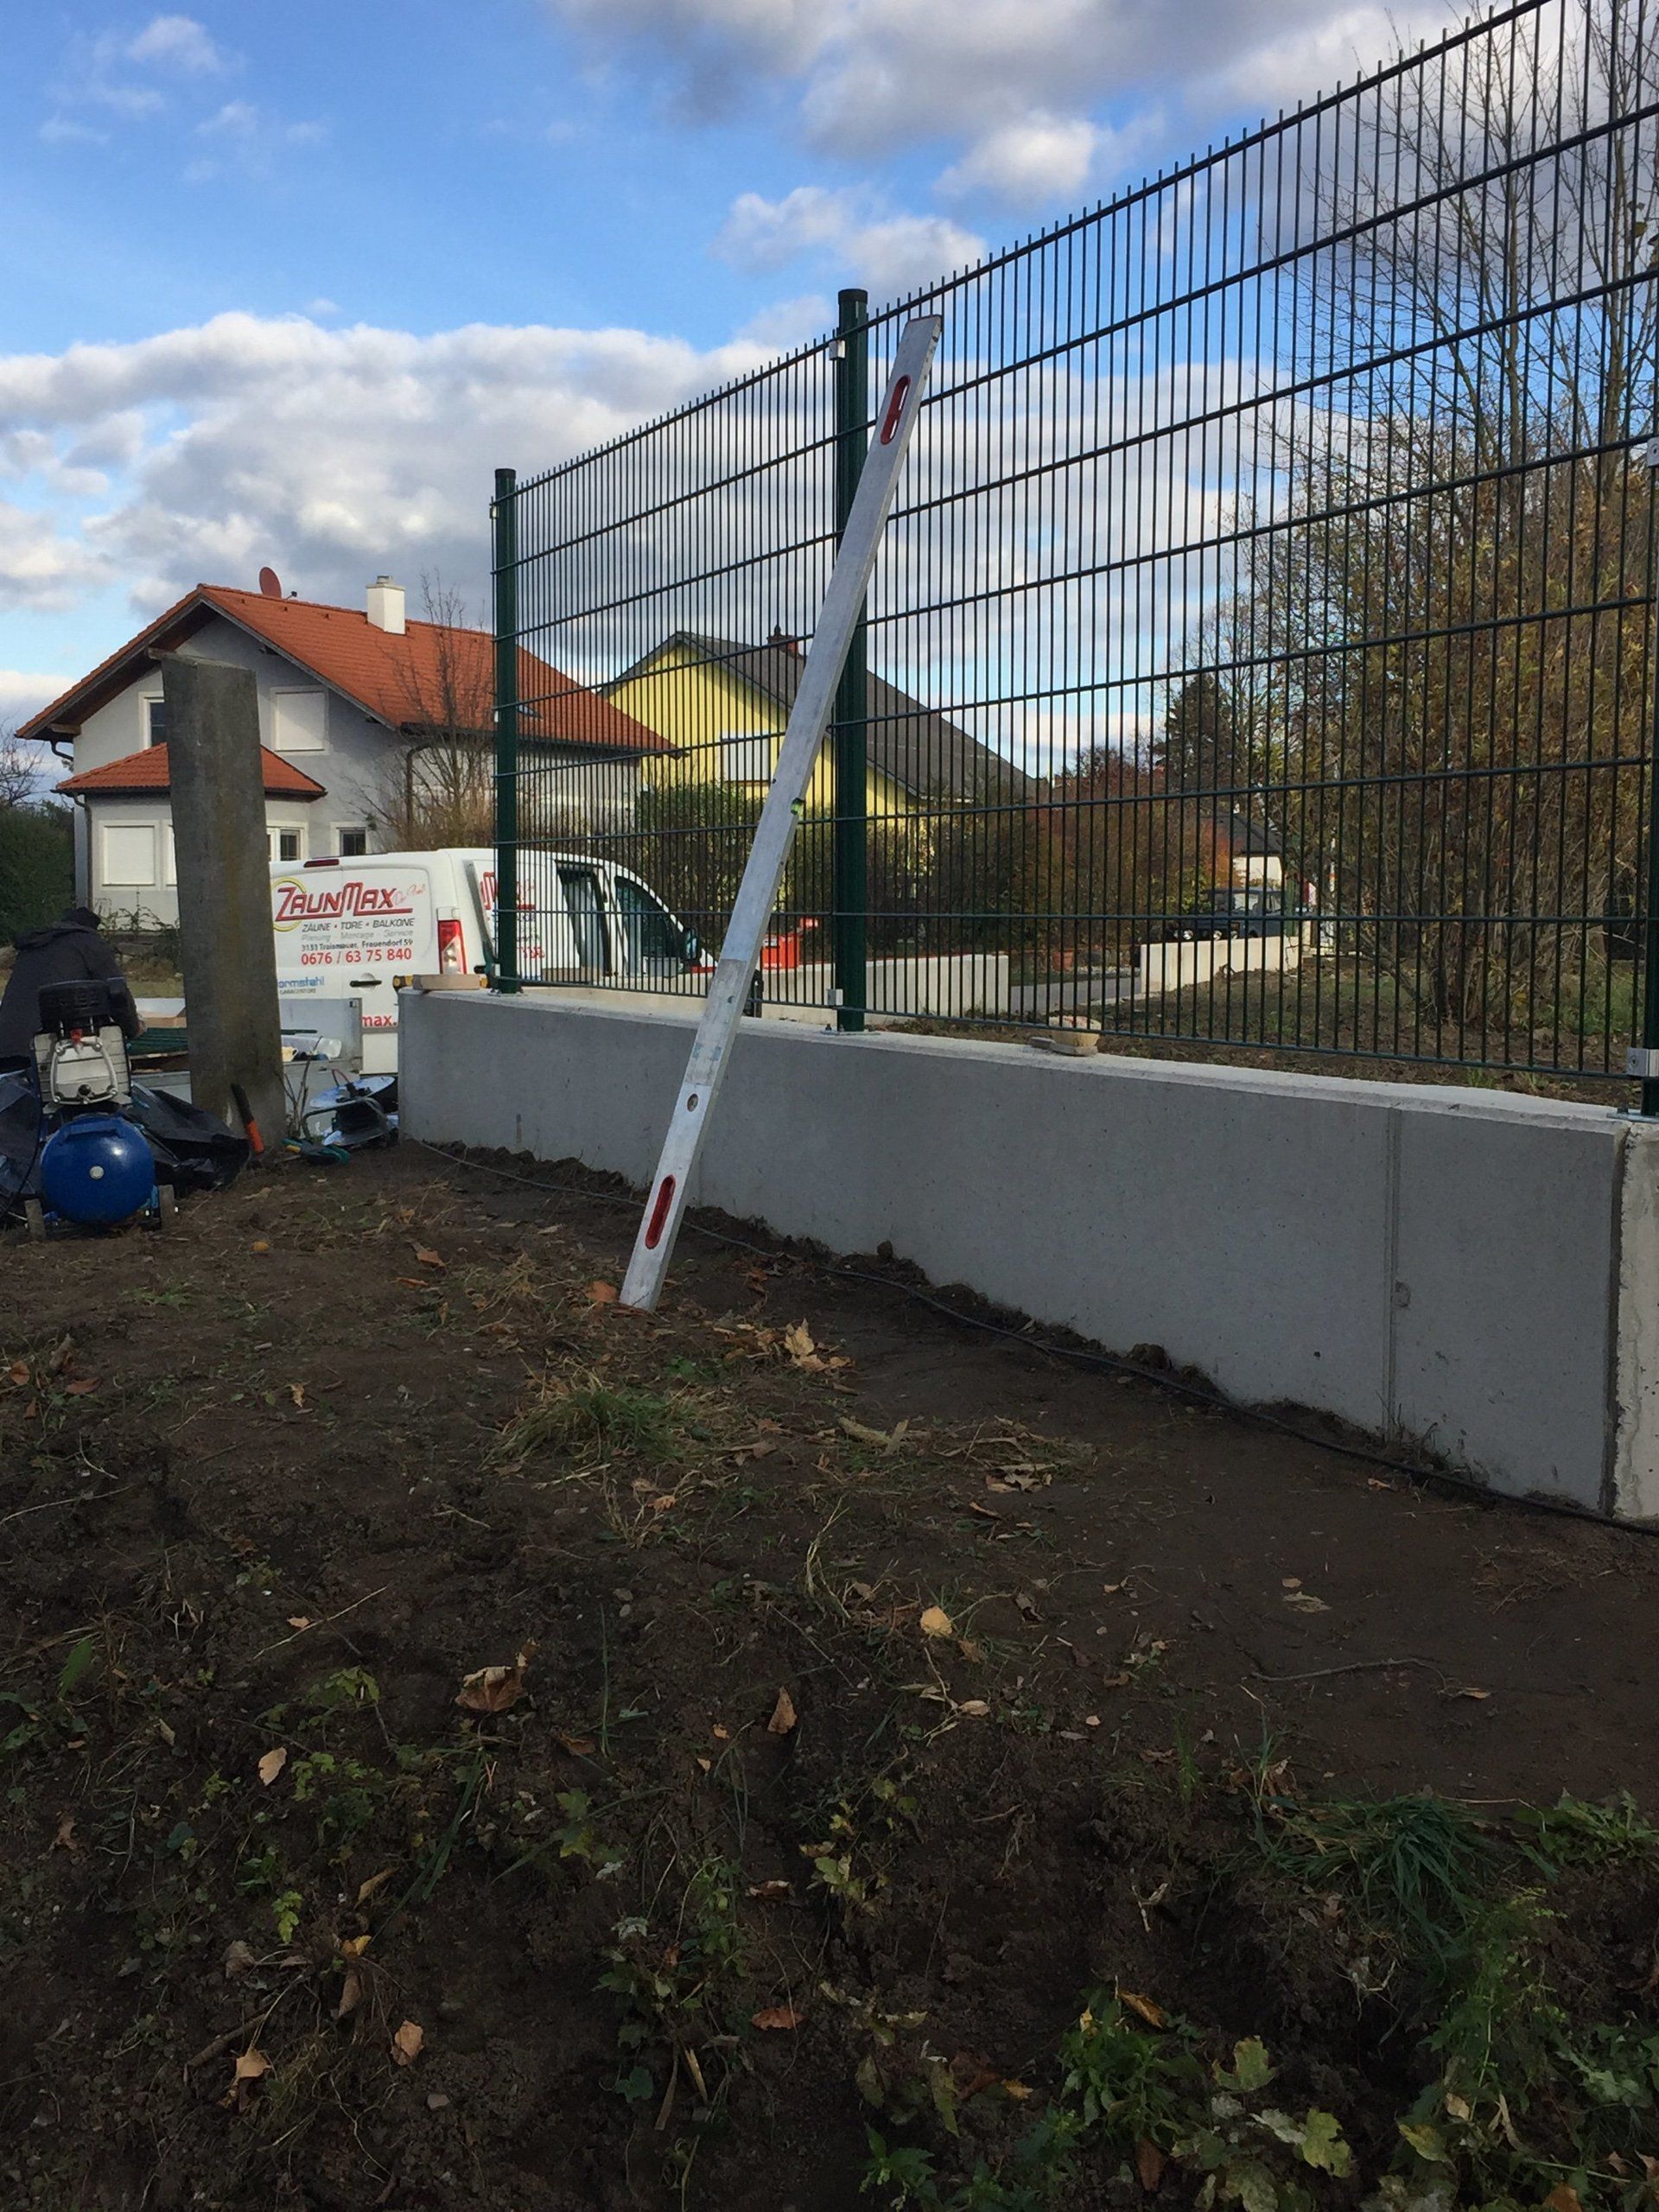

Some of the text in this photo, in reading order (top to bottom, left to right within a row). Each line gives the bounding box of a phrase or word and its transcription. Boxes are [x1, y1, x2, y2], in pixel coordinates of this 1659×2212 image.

[341, 920, 363, 930] TORE
[372, 918, 415, 929] BALKONE
[302, 952, 333, 965] 0676
[346, 950, 361, 963] 63
[366, 950, 382, 962] 75
[387, 948, 412, 961] 840
[278, 976, 324, 988] ormstahl
